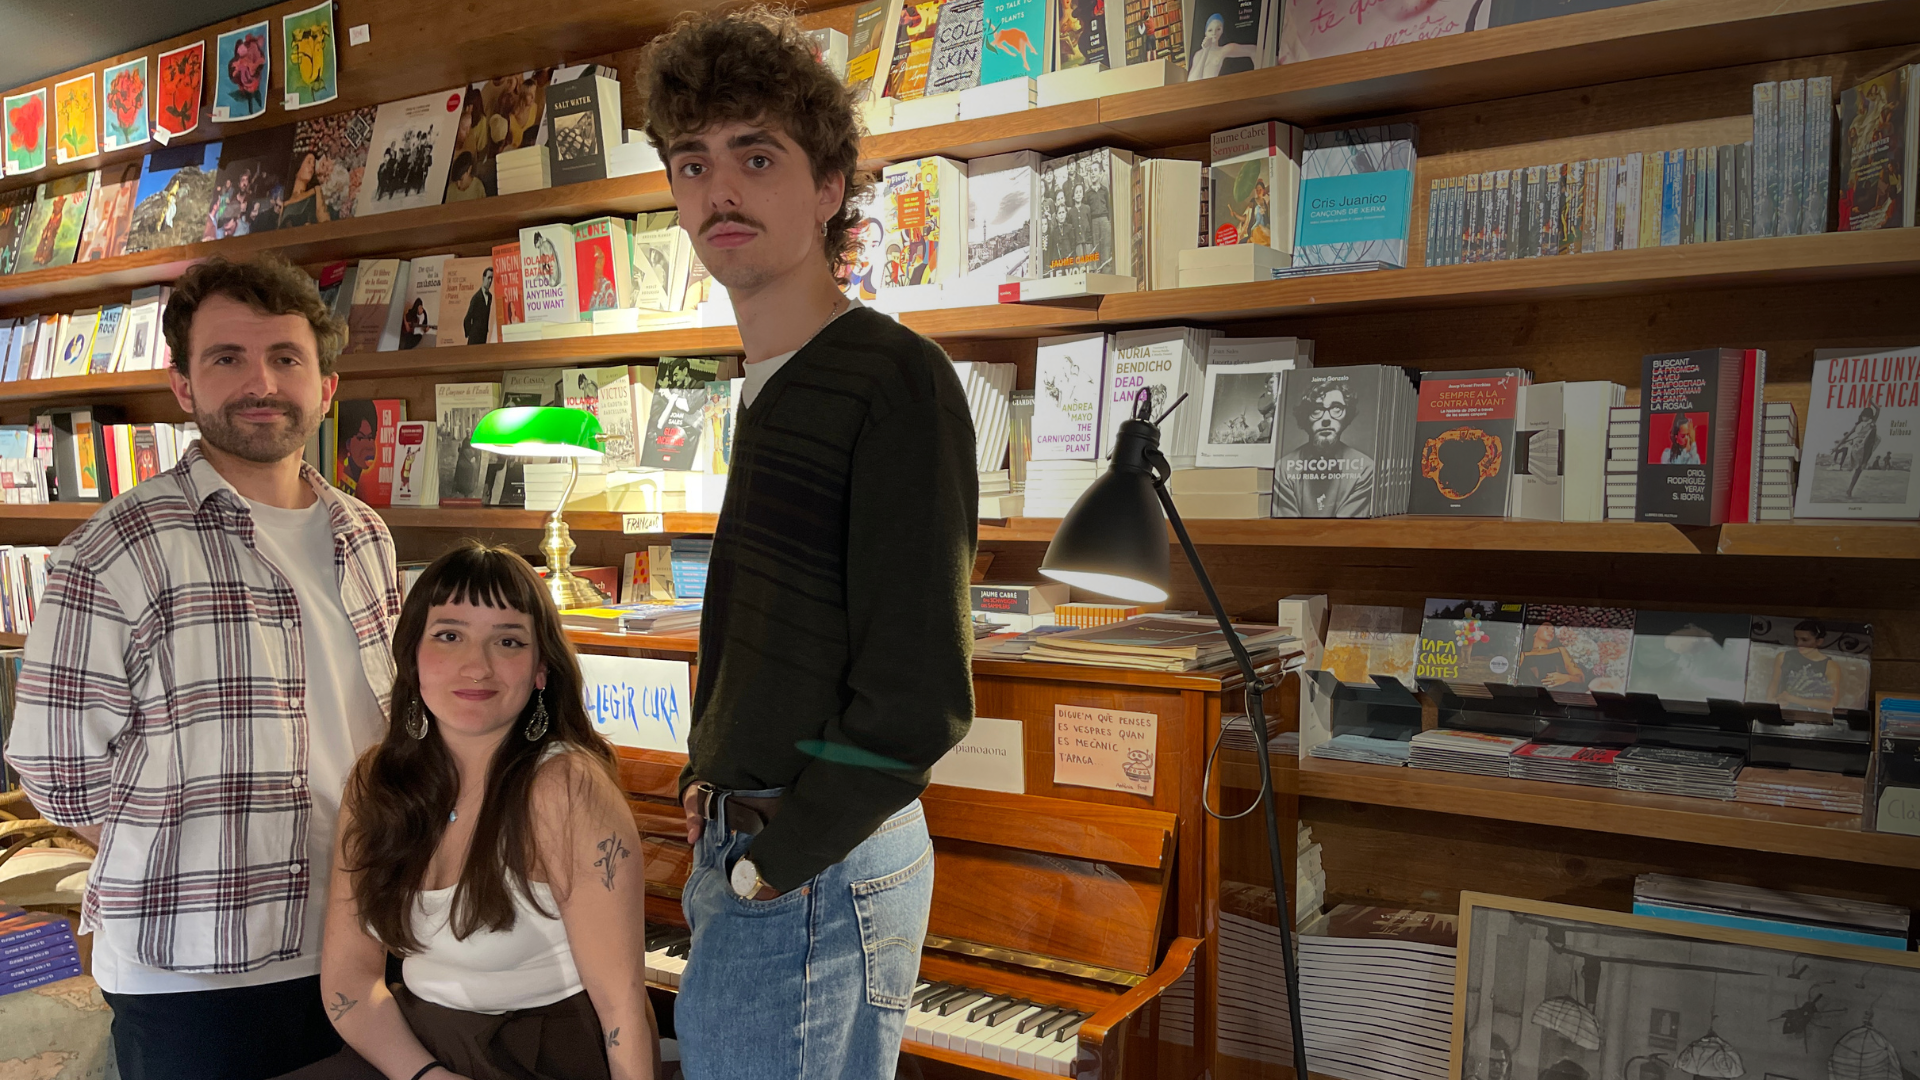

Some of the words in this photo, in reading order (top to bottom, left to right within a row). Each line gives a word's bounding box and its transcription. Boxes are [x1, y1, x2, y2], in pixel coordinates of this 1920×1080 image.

[995, 5, 1004, 13] TO
[1006, 0, 1020, 9] TALK
[1001, 12, 1025, 24] PLANTS
[937, 46, 978, 70] SKIN
[553, 101, 569, 110] SALT
[570, 96, 592, 108] WATER
[1212, 131, 1240, 147] Jaume
[1240, 126, 1266, 141] Cabré
[1212, 143, 1250, 157] Senyoria
[1311, 197, 1335, 209] Cris
[1339, 193, 1387, 207] Juanico
[1310, 208, 1347, 218] CANÇONS
[1361, 205, 1386, 213] XERXA
[575, 221, 608, 239] ALONE
[495, 254, 521, 274] SINGIN
[523, 254, 556, 266] IOLANDA
[1049, 257, 1074, 269] JAUME
[1075, 252, 1100, 264] CABRÉ
[416, 279, 441, 288] música
[501, 273, 509, 286] TO
[509, 272, 519, 285] THE
[525, 279, 538, 289] I'LL
[504, 286, 518, 303] SUN
[526, 288, 563, 300] ANYTHING
[526, 301, 541, 311] YOU
[543, 299, 564, 310] WANT
[100, 312, 120, 323] CANET
[98, 324, 115, 334] ROCK
[1116, 360, 1172, 374] BENDICHO
[1652, 358, 1690, 368] BUSCANT
[1828, 356, 1920, 384] CATALUNYA
[523, 376, 546, 384] CASALS
[1115, 376, 1144, 388] DEAD
[600, 386, 628, 400] VICTUS
[1439, 391, 1475, 400] SEMPRE
[1477, 390, 1484, 398] A
[1486, 390, 1498, 398] LA
[1826, 382, 1919, 409] FLAMENCA
[1062, 402, 1093, 413] ANDREA
[1430, 399, 1468, 408] CONTRA
[1475, 398, 1506, 407] AVANT
[1650, 403, 1661, 411] LA
[1662, 401, 1693, 410] ROSALÍA
[1070, 413, 1093, 422] MAYO
[1077, 423, 1092, 432] THE
[1037, 434, 1091, 444] CARNIVOROUS
[1066, 444, 1090, 453] PLANT
[1286, 456, 1364, 471] PSICÒPTIC!
[1687, 469, 1706, 477] ORIOL
[1684, 485, 1705, 493] YERAY
[1672, 492, 1679, 500] S.
[1680, 493, 1704, 501] IBORRA
[999, 591, 1017, 599] CABRÉ
[1419, 652, 1458, 665] CAIGU
[1416, 664, 1458, 679] DISTES
[642, 680, 680, 744] CURA
[1058, 709, 1093, 721] DIGUE'M
[1119, 716, 1151, 727] PENSES
[1058, 723, 1069, 732] ES
[1073, 725, 1112, 737] VESPRES
[1119, 730, 1145, 740] QUAN
[1058, 737, 1069, 746] ES
[1076, 738, 1118, 752] MECÀNIC
[1887, 799, 1920, 822] Clà
